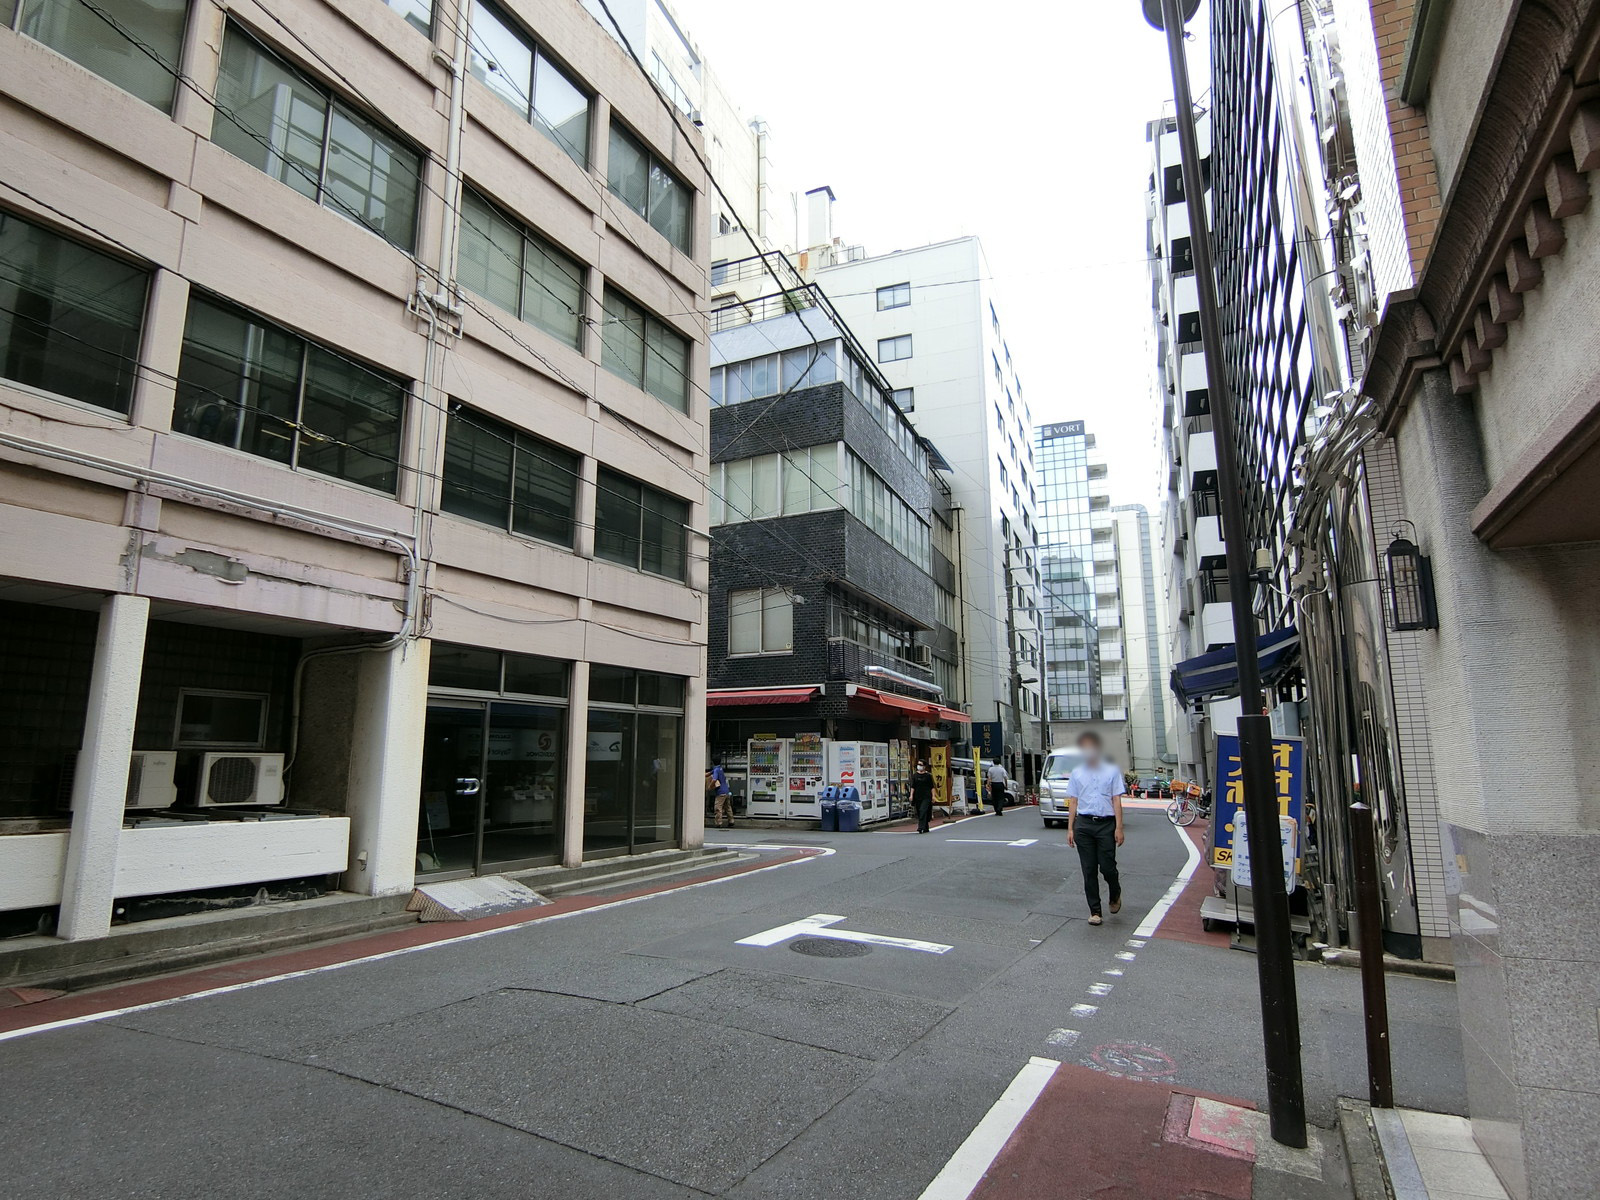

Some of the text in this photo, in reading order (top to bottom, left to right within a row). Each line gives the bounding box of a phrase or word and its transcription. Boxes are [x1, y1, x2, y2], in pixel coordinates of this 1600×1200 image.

[1053, 424, 1081, 434] VORT
[935, 774, 943, 798] カレー
